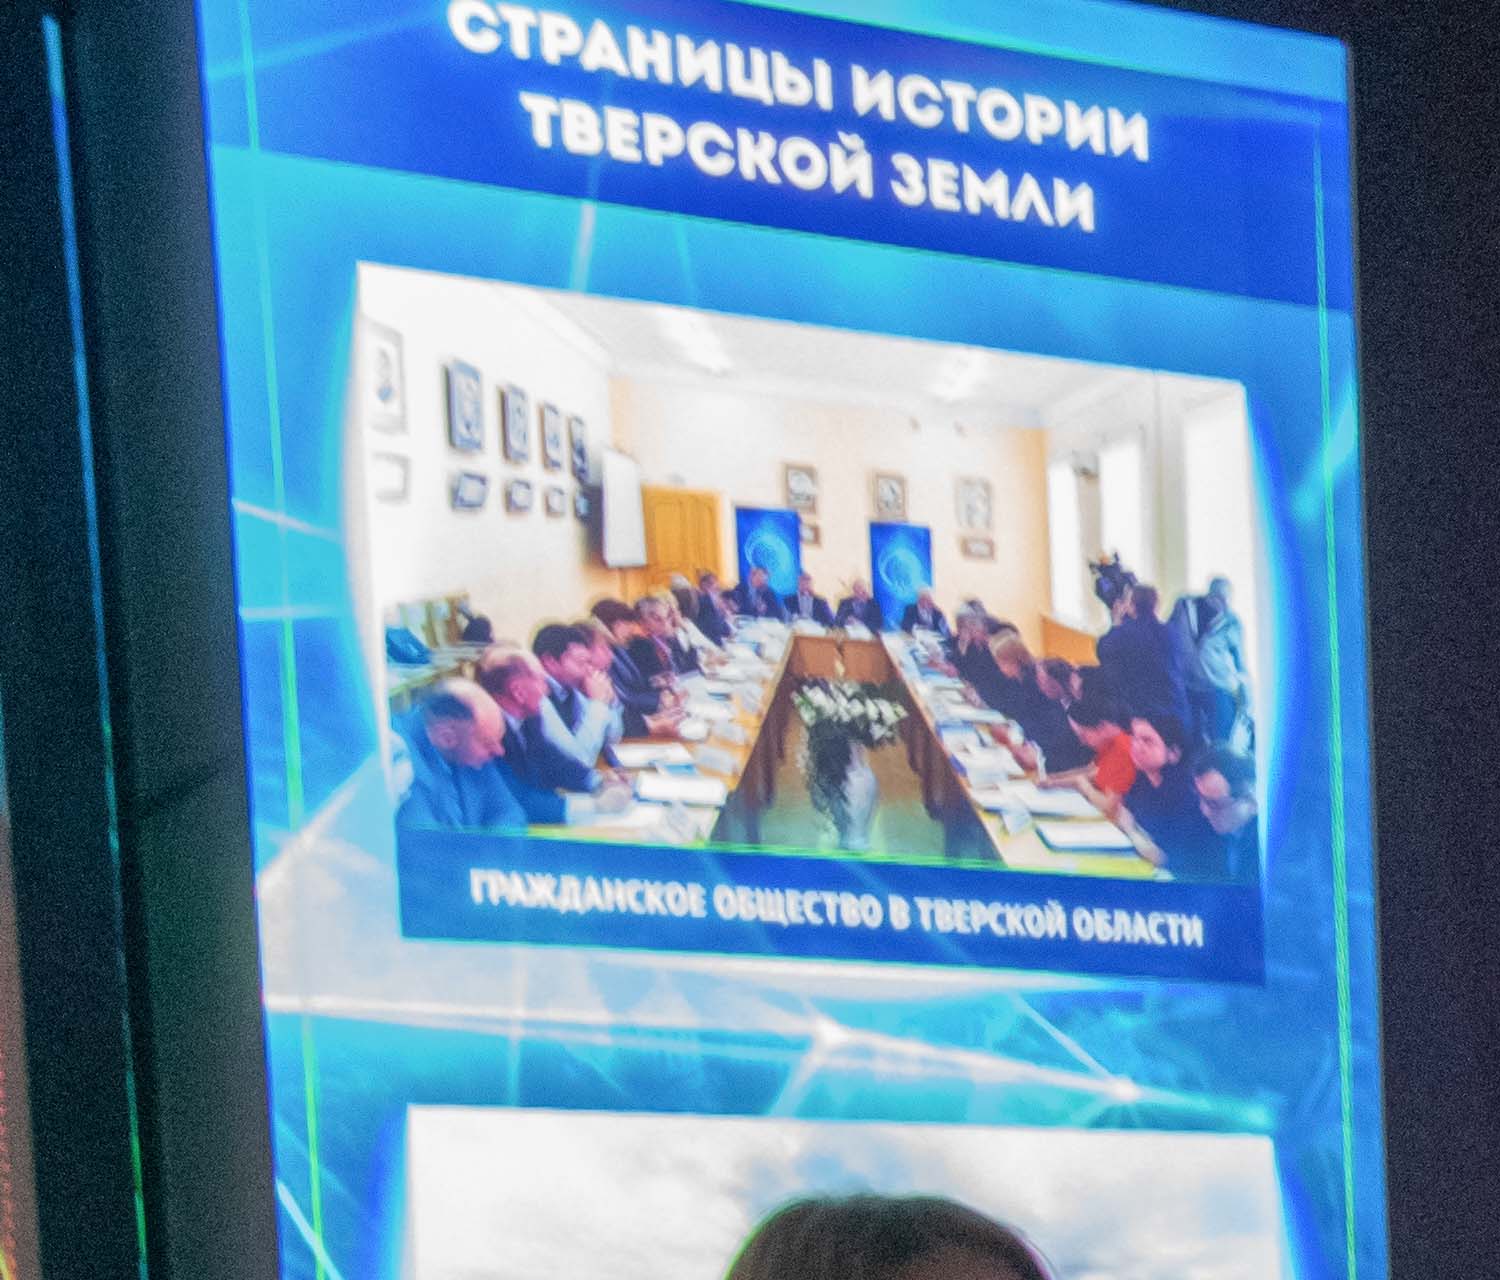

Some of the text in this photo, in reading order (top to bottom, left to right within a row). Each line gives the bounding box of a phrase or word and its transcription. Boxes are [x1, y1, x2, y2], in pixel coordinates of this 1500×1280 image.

[448, 0, 1150, 163] СТРАНИЦЫ ИСТОРИИ
[519, 91, 1096, 233] ТВЕРСКОЙ ЗЕМЛИ
[469, 868, 1205, 948] ГРАЖДАНСКОЕ ОБЩЕСТВО В ТВЕРСКОЙ ОБЛАСТИ
